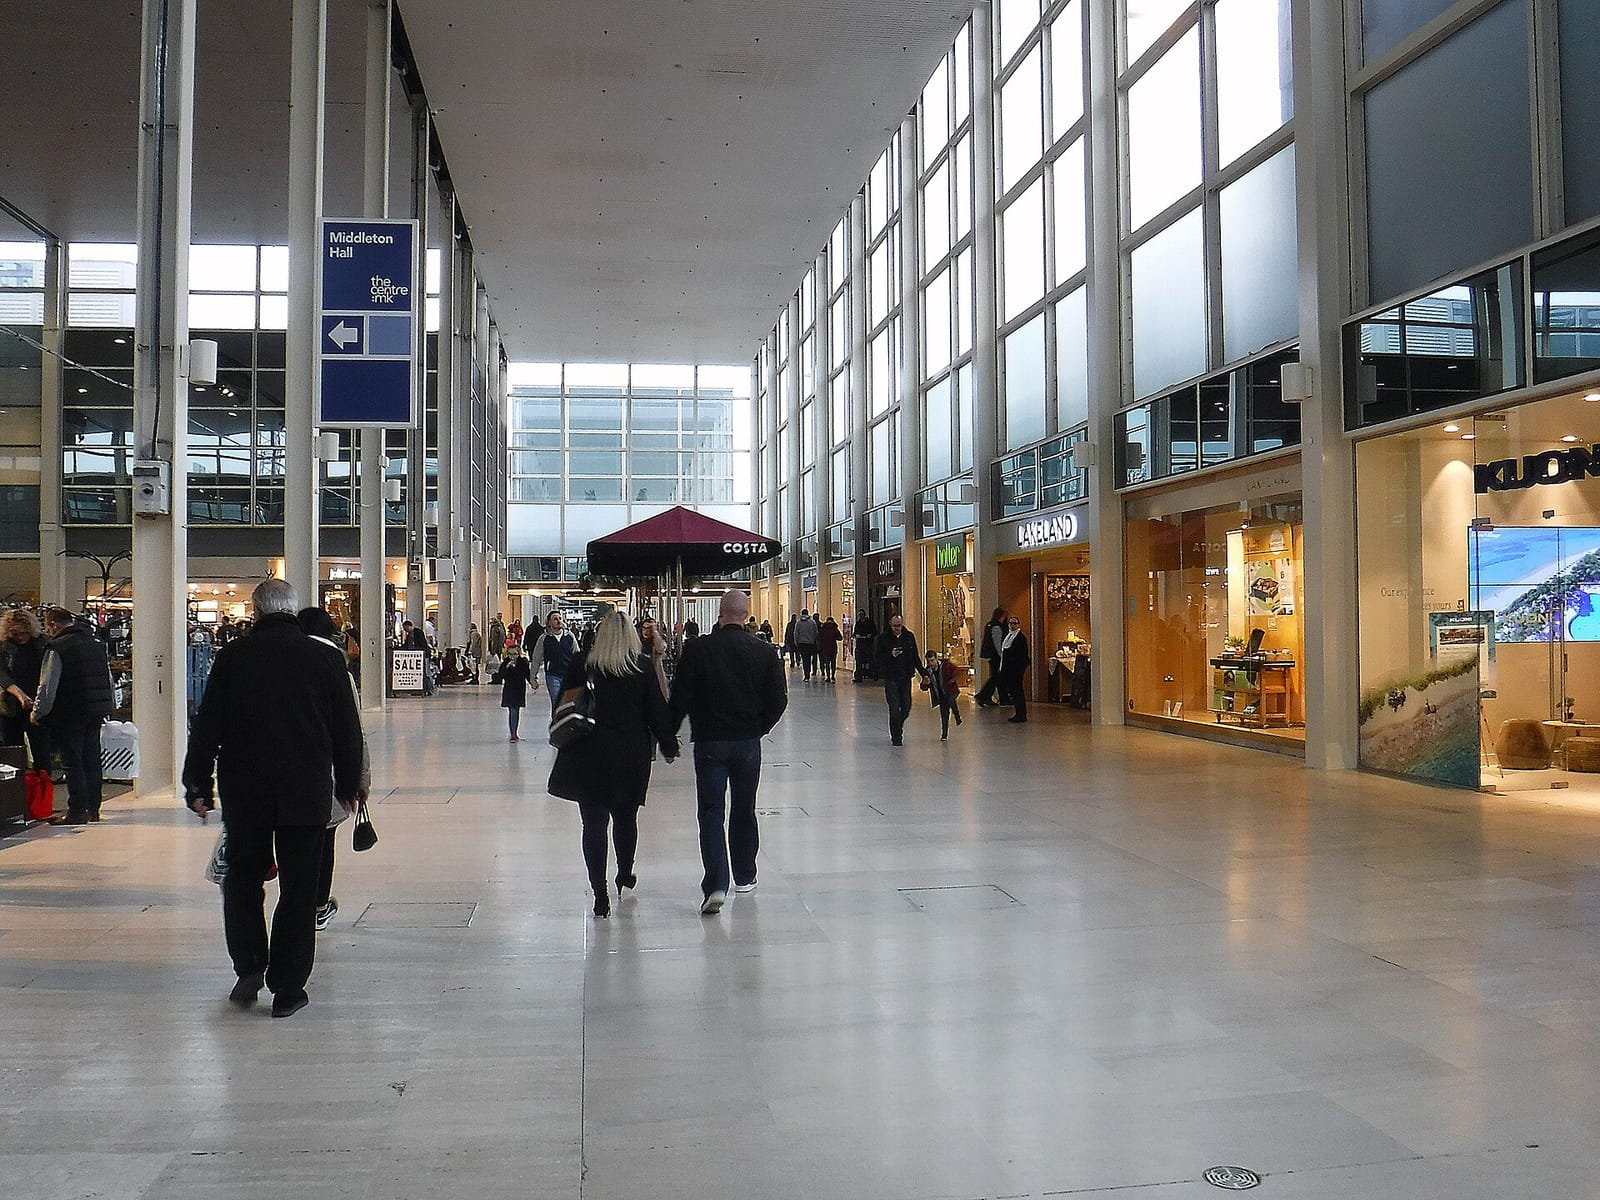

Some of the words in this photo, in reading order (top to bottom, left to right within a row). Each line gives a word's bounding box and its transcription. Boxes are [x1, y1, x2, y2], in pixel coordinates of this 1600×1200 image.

[329, 231, 394, 244] Middleton
[329, 246, 353, 258] Hall
[370, 274, 392, 287] the
[370, 285, 409, 296] centre
[371, 291, 394, 304] :mk
[1017, 513, 1078, 547] LAKELAND
[723, 542, 768, 554] COSTA
[937, 542, 961, 569] hotter
[878, 559, 895, 577] COSTA
[394, 659, 421, 670] SALE
